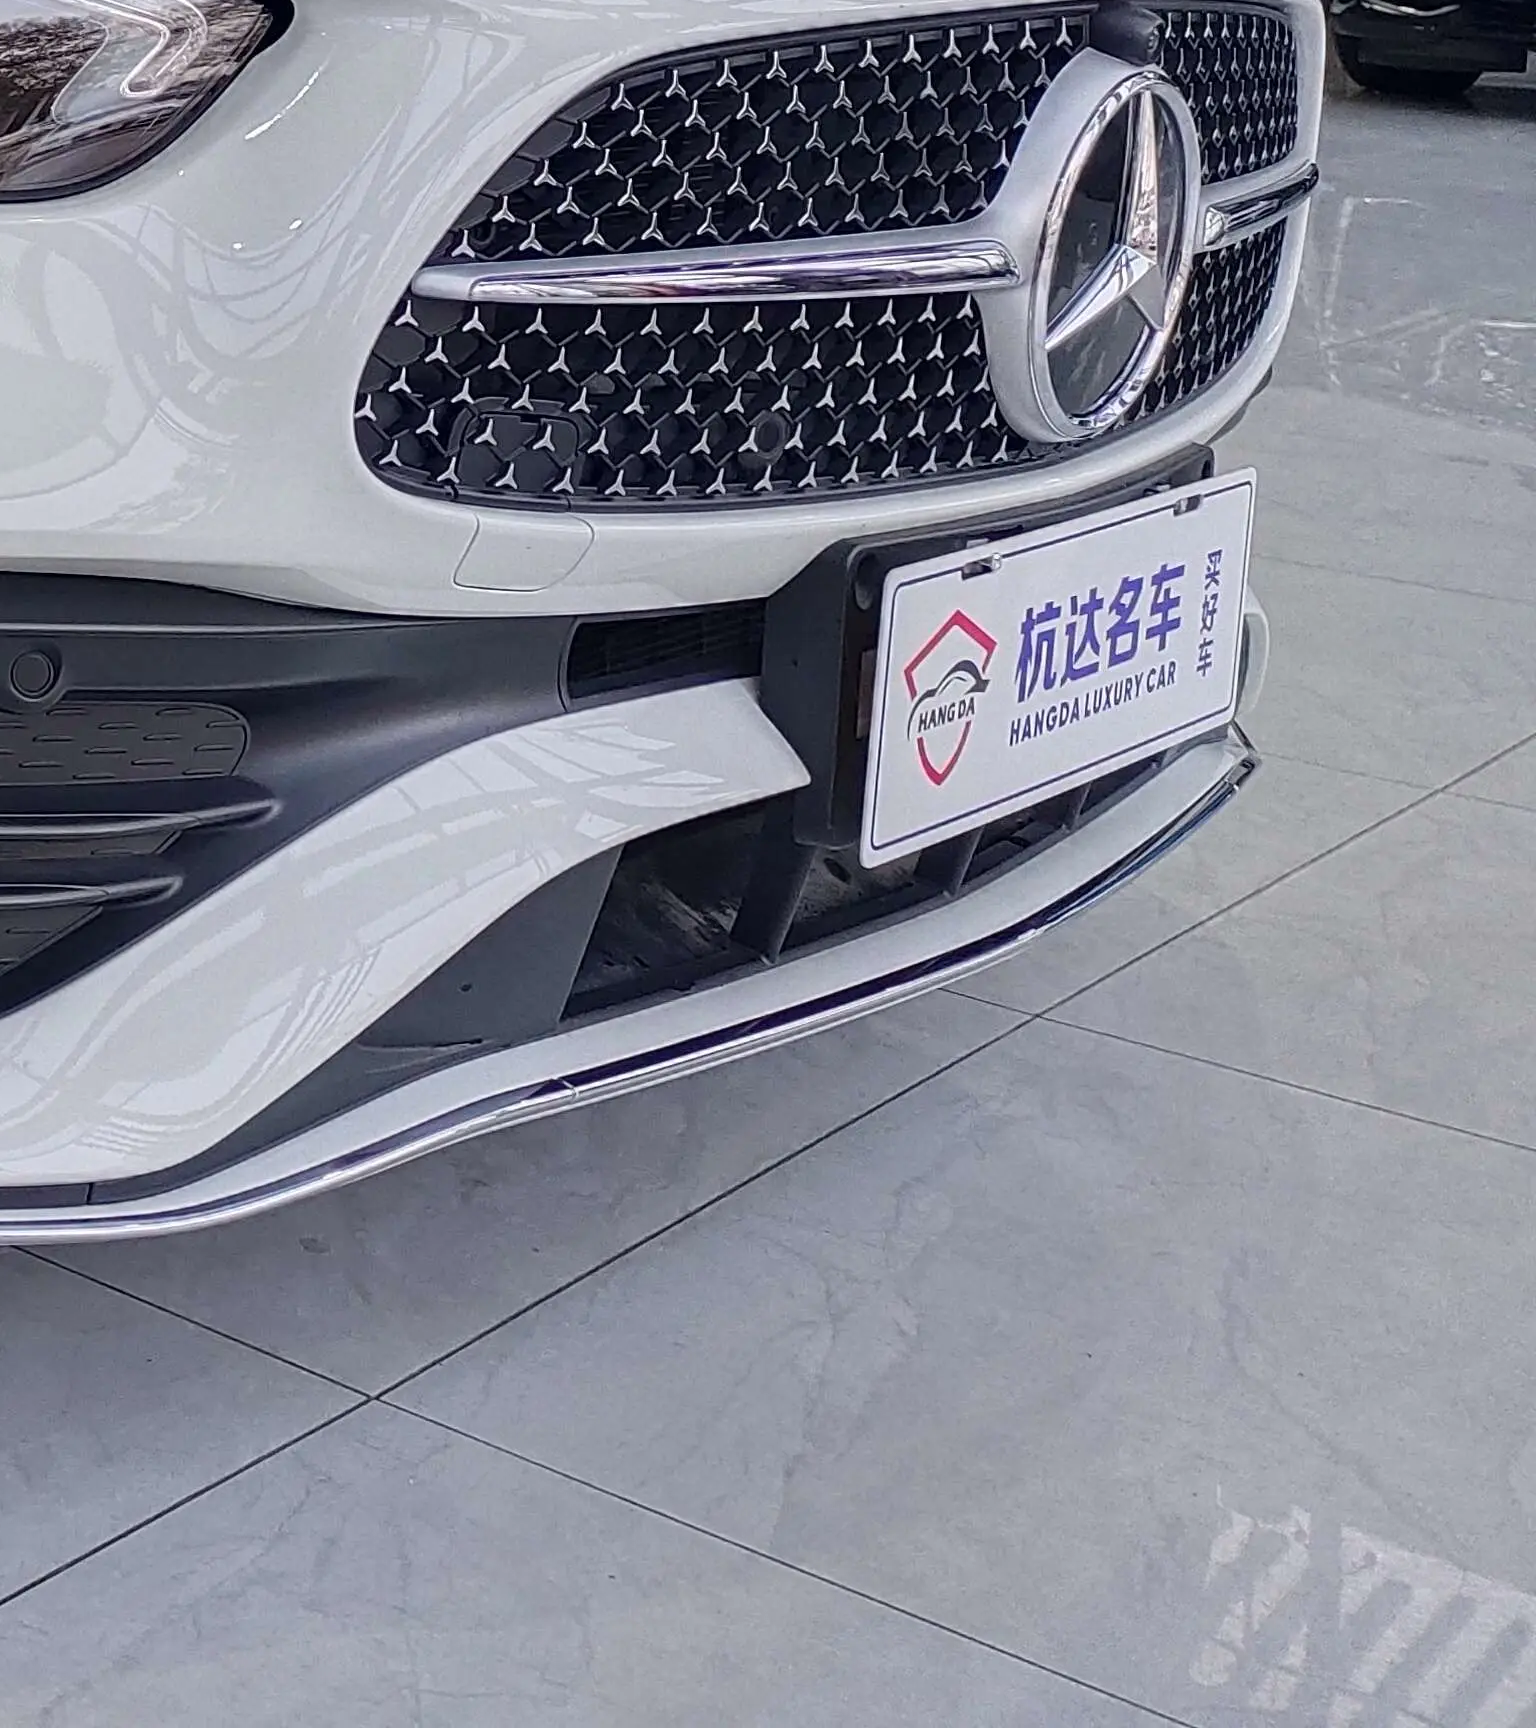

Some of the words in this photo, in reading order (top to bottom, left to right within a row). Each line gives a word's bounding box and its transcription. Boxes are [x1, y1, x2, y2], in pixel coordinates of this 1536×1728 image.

[1015, 563, 1186, 704] 杭达名车
[1196, 549, 1223, 677] 买好车
[917, 701, 957, 733] HANG
[957, 696, 976, 718] DA
[1008, 698, 1080, 747] HANGDA
[1083, 671, 1145, 718] LUXURY
[1145, 660, 1177, 694] CAR
